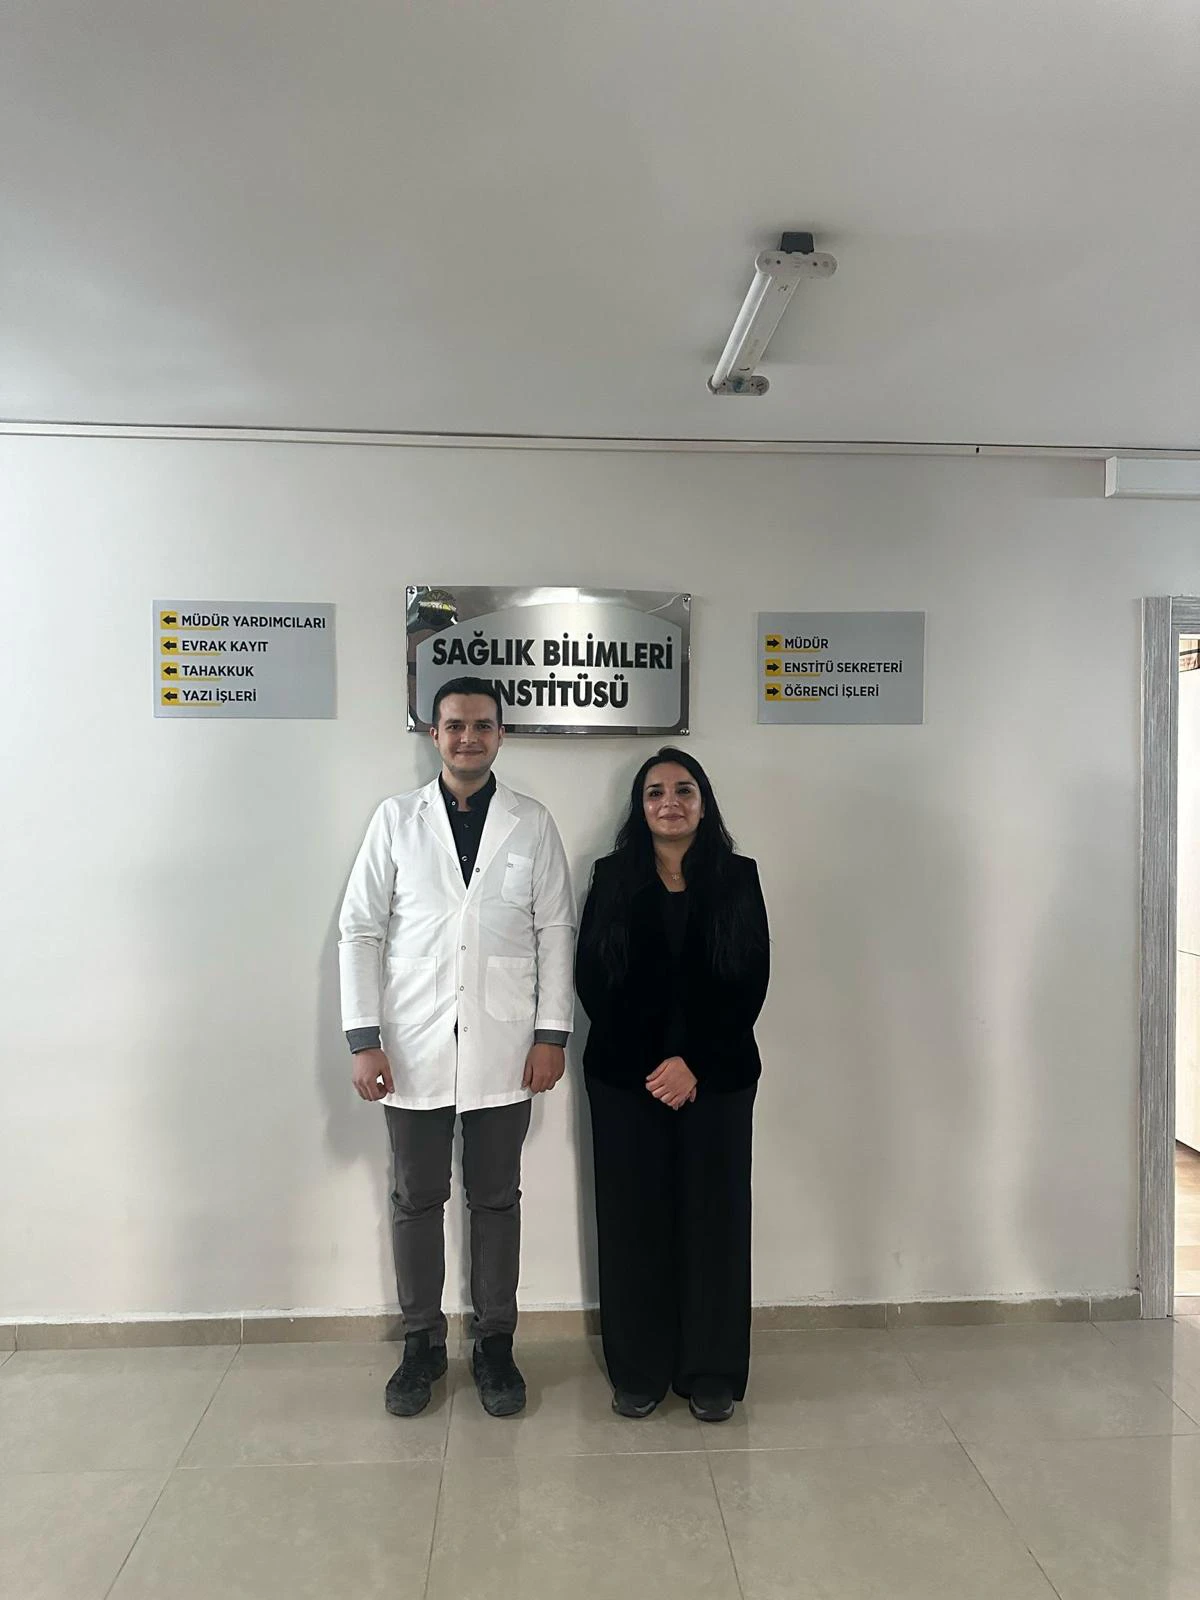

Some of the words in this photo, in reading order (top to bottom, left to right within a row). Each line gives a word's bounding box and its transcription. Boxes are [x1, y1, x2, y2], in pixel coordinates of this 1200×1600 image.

[182, 613, 229, 627] MÜDÜR
[233, 616, 326, 628] YARDIMCILARI
[182, 640, 227, 651] EVRAK
[230, 641, 269, 652] KAYIT
[784, 636, 829, 649] MÜDÜR
[432, 631, 536, 666] SAĞLIK
[543, 632, 673, 669] BİLİMLERİ
[182, 665, 254, 677] TAHAKKUK
[784, 660, 834, 673] ENSTİTÜ
[837, 660, 903, 673] SEKRETERİ
[182, 690, 212, 701] YAZI
[216, 688, 257, 703] İŞLERİ
[485, 672, 629, 708] NSTİTÜSÜ
[784, 684, 839, 697] ÖĞRENCİ
[842, 684, 880, 698] İŞLERİ
